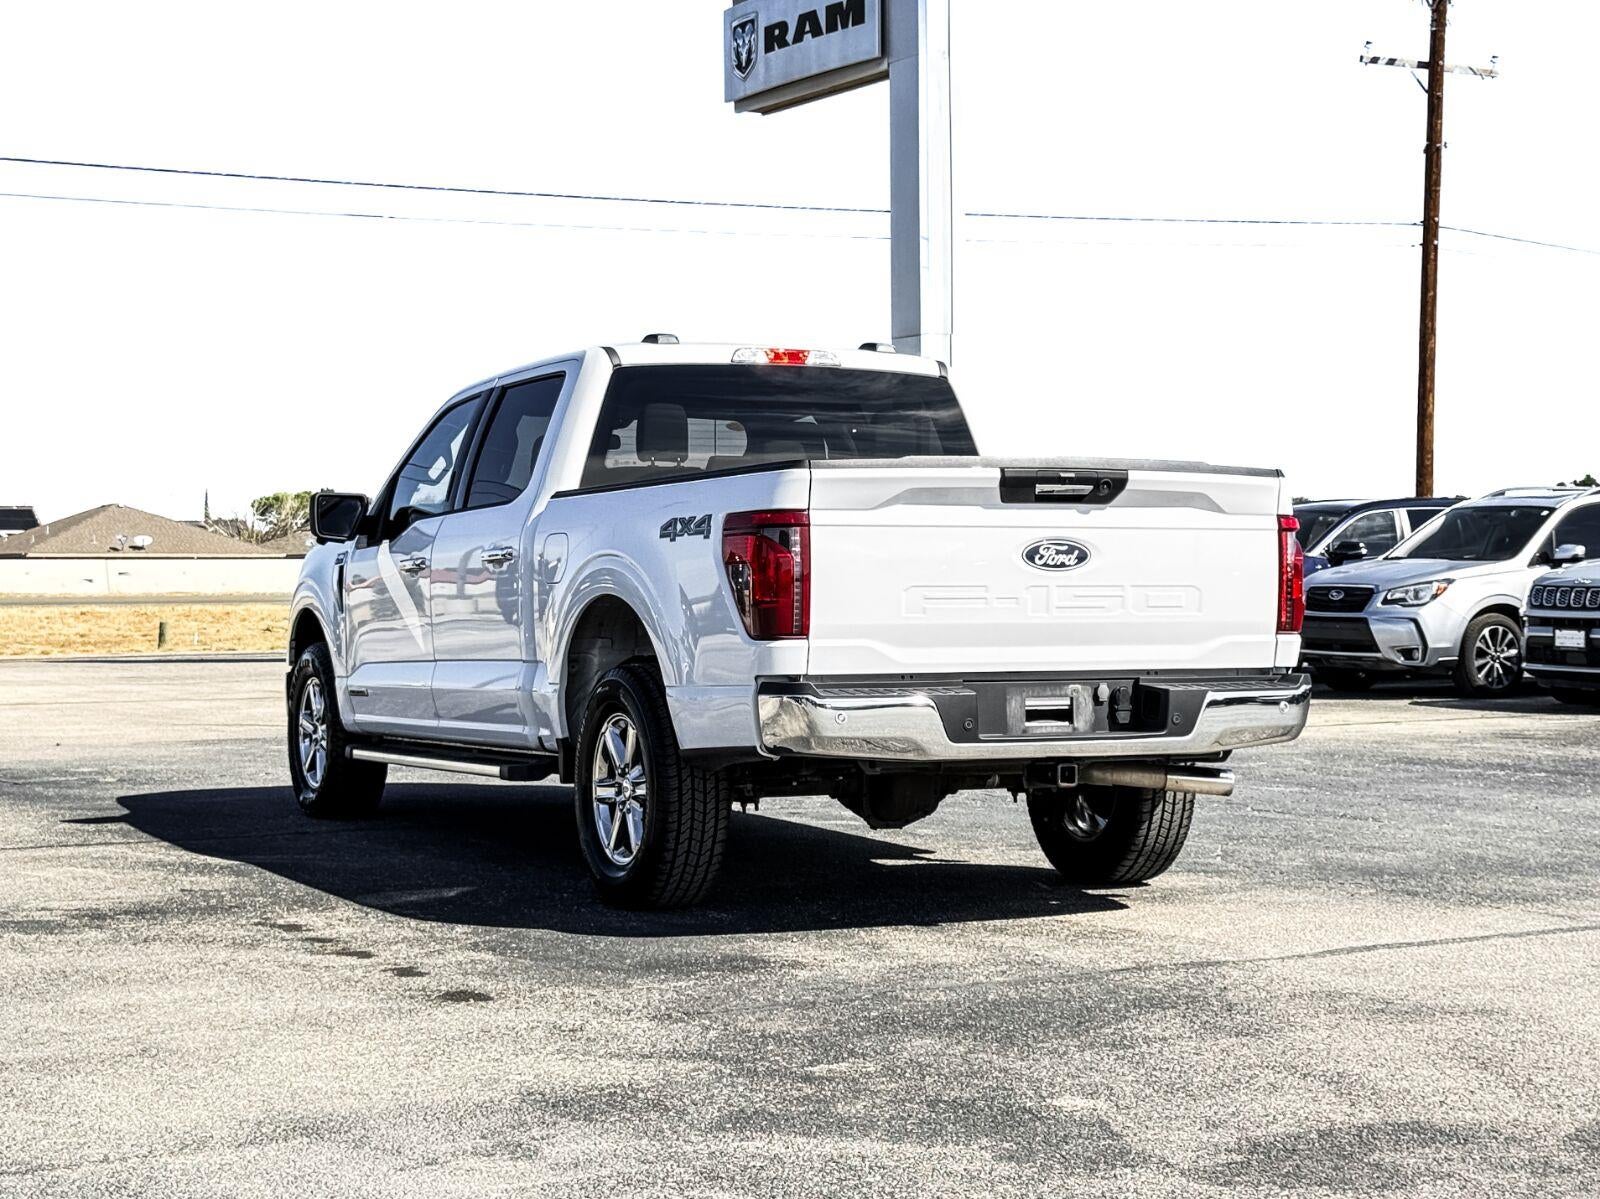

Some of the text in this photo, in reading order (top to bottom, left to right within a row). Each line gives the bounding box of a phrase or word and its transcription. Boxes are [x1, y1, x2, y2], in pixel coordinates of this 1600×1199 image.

[763, 0, 866, 55] RAM
[1034, 542, 1079, 566] Ford
[902, 584, 1203, 617] F-150
